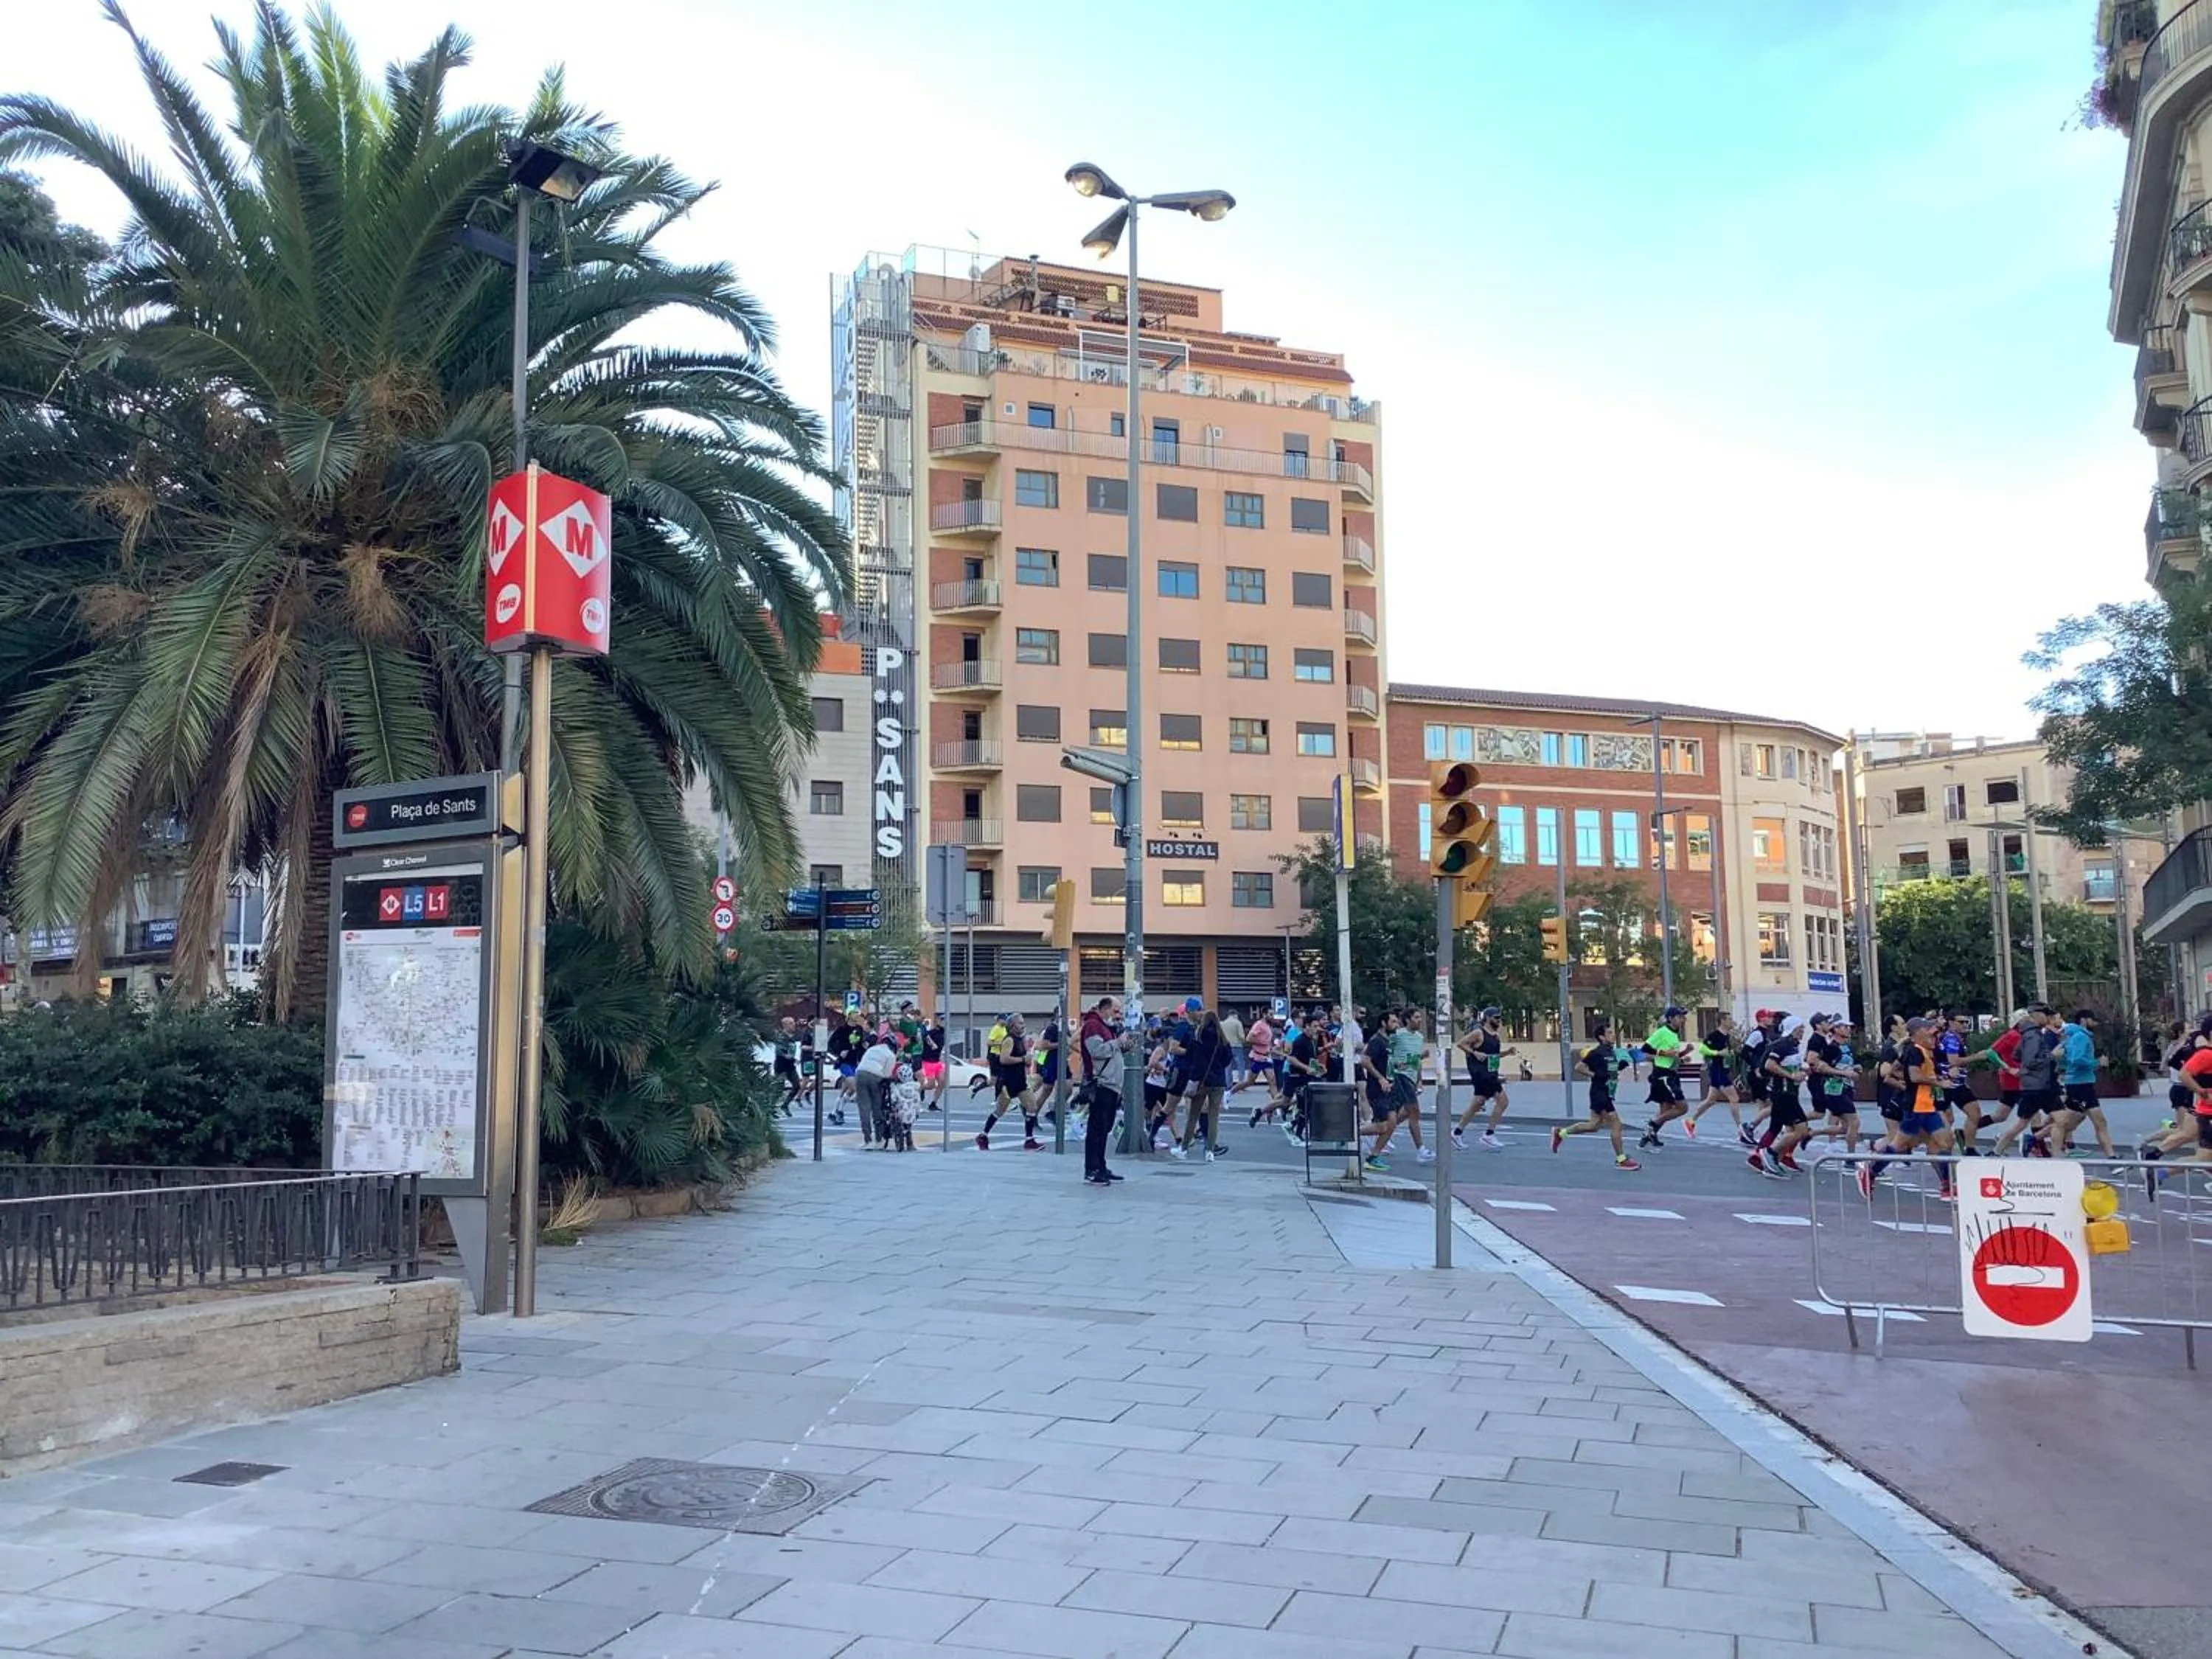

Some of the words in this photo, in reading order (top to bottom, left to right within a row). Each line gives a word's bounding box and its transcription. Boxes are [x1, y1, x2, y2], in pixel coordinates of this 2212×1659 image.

[491, 515, 507, 557] M
[566, 516, 593, 560] M
[499, 597, 517, 612] TMB
[391, 804, 422, 821] Plaça
[425, 801, 440, 815] de
[442, 798, 476, 814] Sants
[1150, 843, 1216, 856] HOSTAL
[405, 894, 422, 913] L5
[428, 891, 445, 911] L1
[717, 914, 731, 924] 30
[847, 993, 858, 1009] P
[1275, 999, 1284, 1013] P
[2006, 1181, 2055, 1189] Ajuntament
[2018, 1189, 2062, 1198] Barcelona
